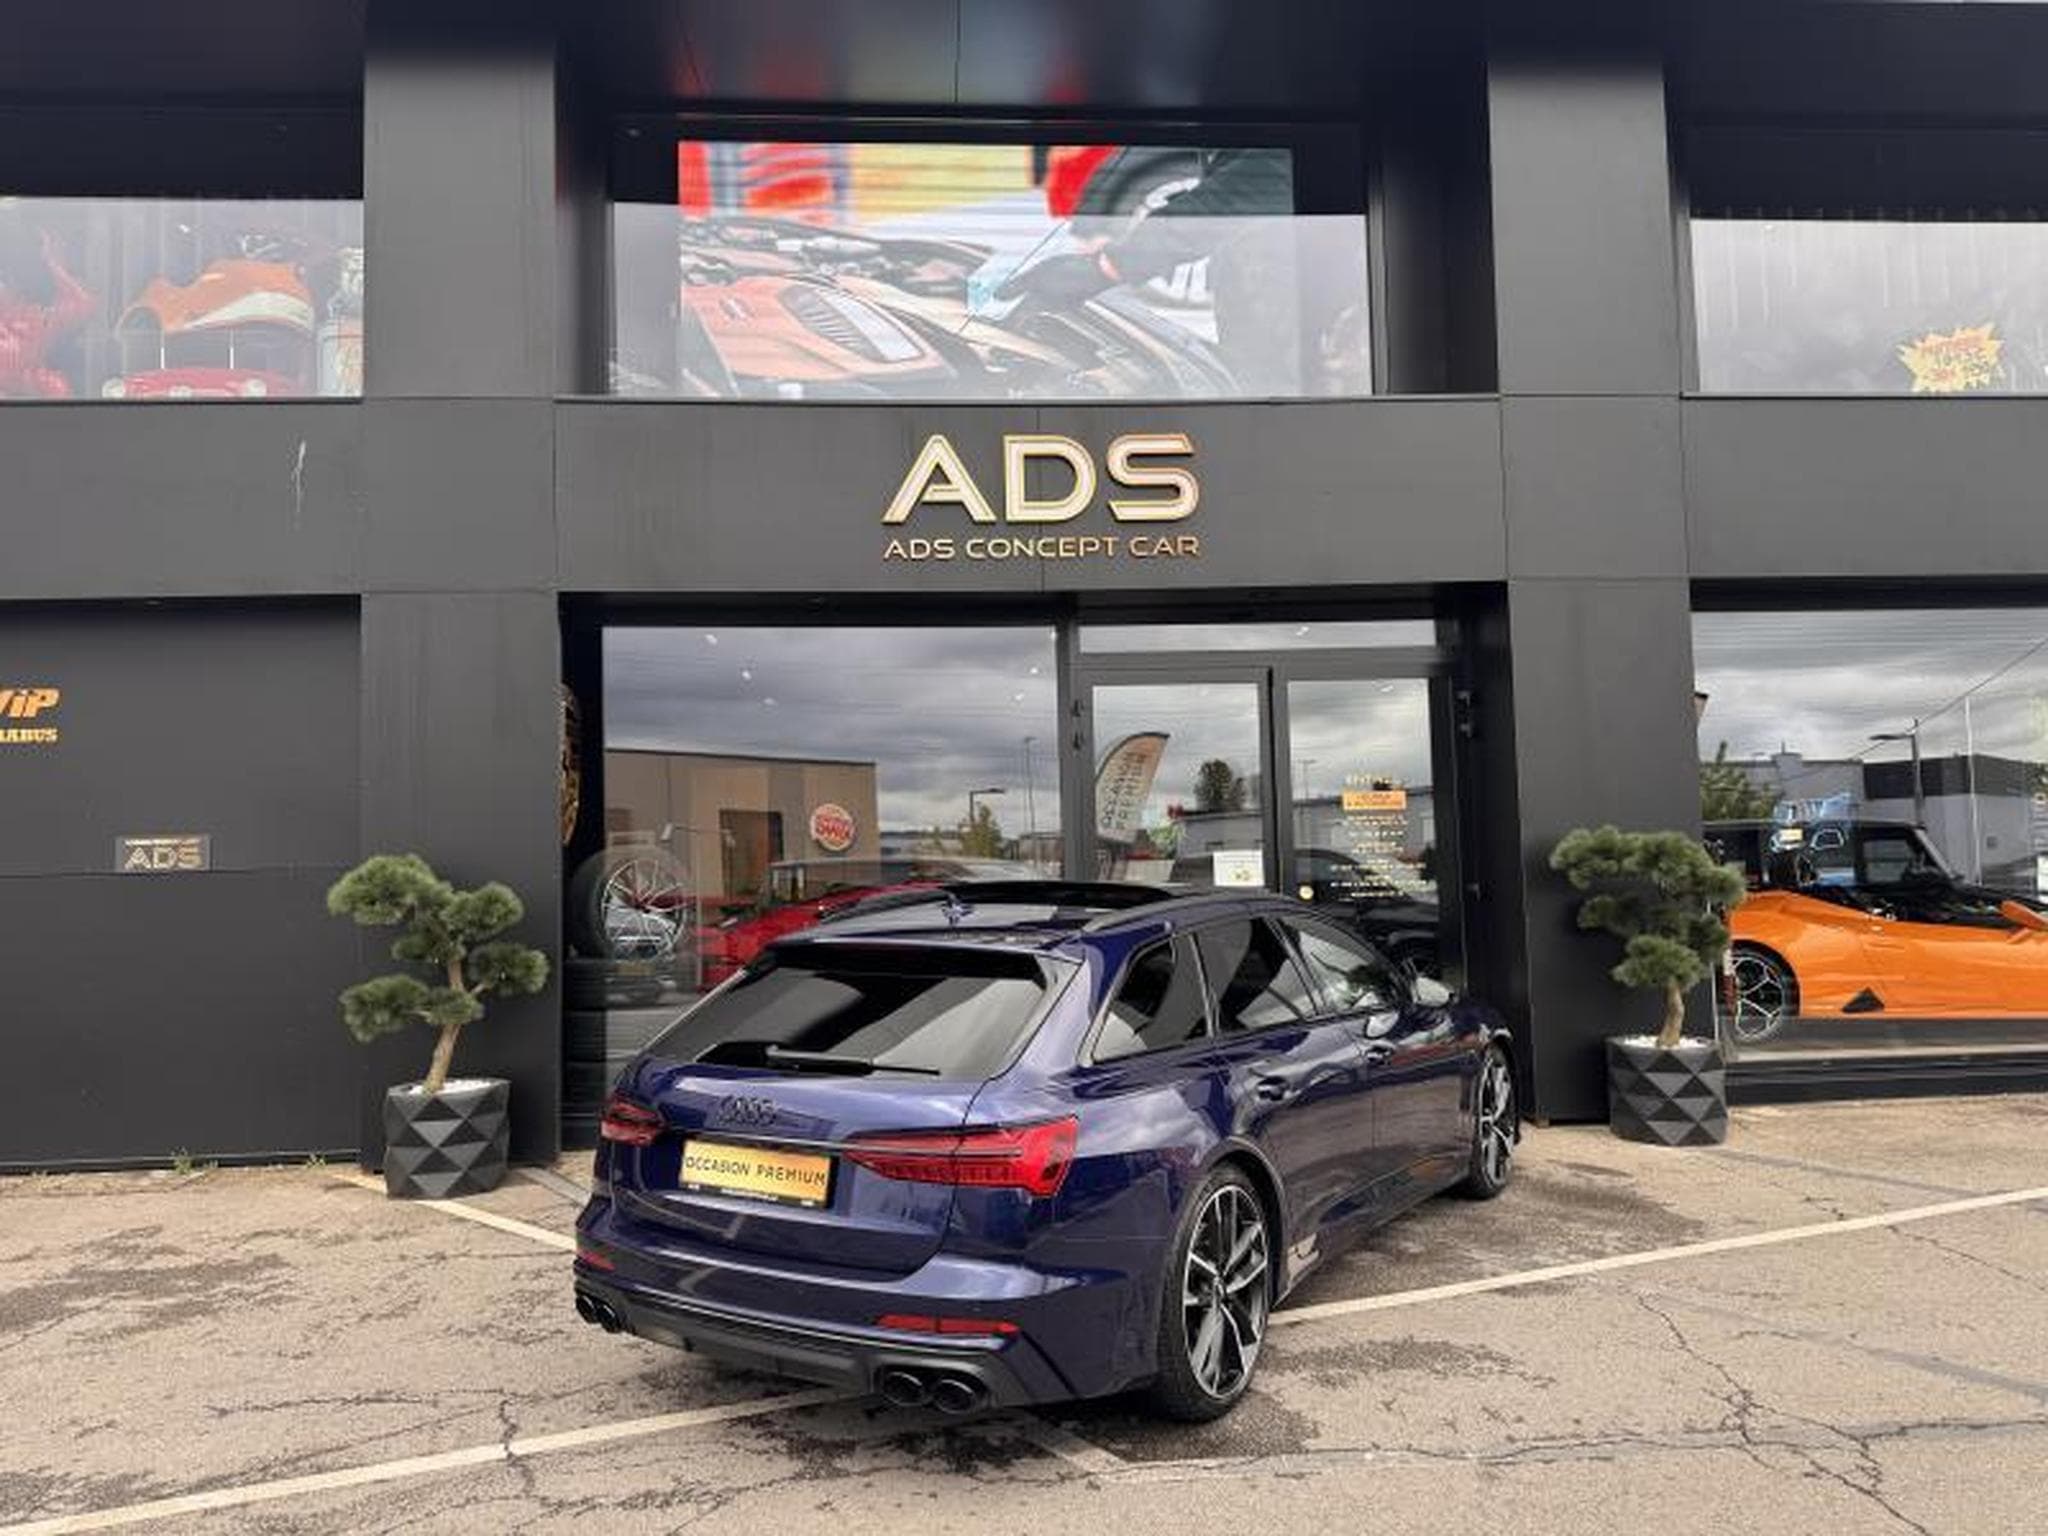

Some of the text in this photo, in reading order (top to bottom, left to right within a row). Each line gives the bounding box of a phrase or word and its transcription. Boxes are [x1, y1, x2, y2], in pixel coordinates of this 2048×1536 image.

[881, 433, 1200, 524] ADS
[882, 535, 1200, 561] ADS CONCEPT CAR
[124, 846, 202, 870] ADS
[685, 1155, 826, 1187] OCCASION PREMIUM
